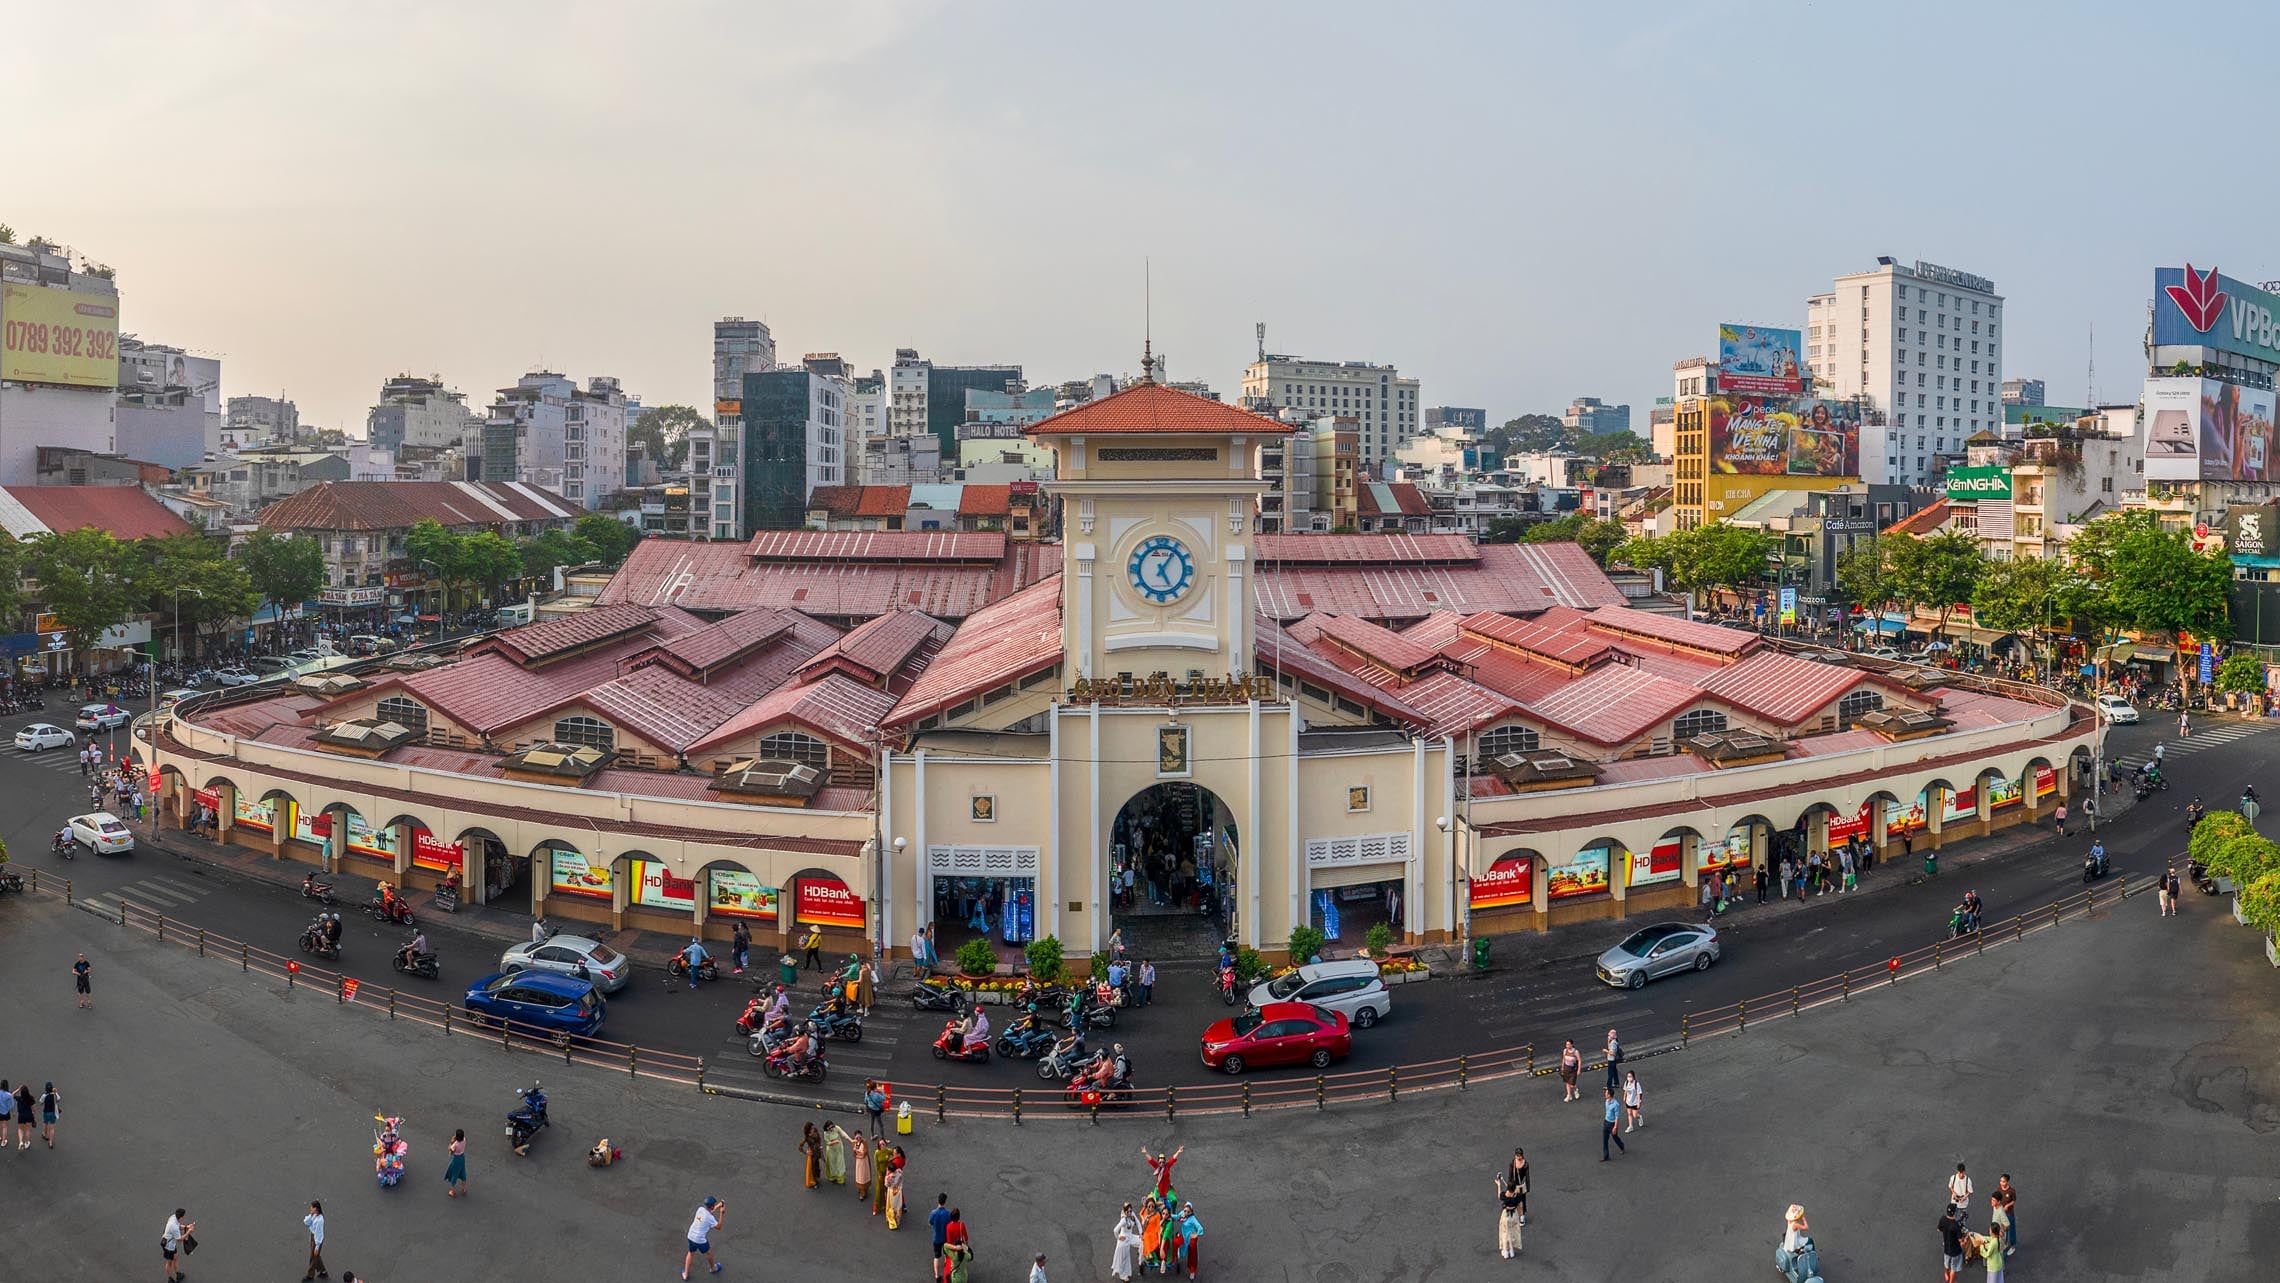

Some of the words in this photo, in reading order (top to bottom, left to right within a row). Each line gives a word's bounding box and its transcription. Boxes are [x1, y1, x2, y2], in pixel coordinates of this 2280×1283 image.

[6, 320, 48, 353] 0789
[52, 325, 82, 357] 392
[86, 329, 115, 360] 392
[1753, 404, 1779, 416] pepsi
[1725, 416, 1763, 432] MANG
[970, 425, 991, 437] HALO
[994, 425, 1019, 437] HOTEL
[1754, 432, 1779, 449] NHÀ
[1826, 518, 1844, 530] Café
[1844, 520, 1874, 530] Amazon
[2235, 540, 2263, 549] SAIGON
[399, 573, 419, 582] VISSAN
[1829, 813, 1861, 826] HDBank
[1634, 854, 1678, 868] HDBank
[645, 875, 694, 892] HDBank
[804, 885, 850, 899] HDBank
